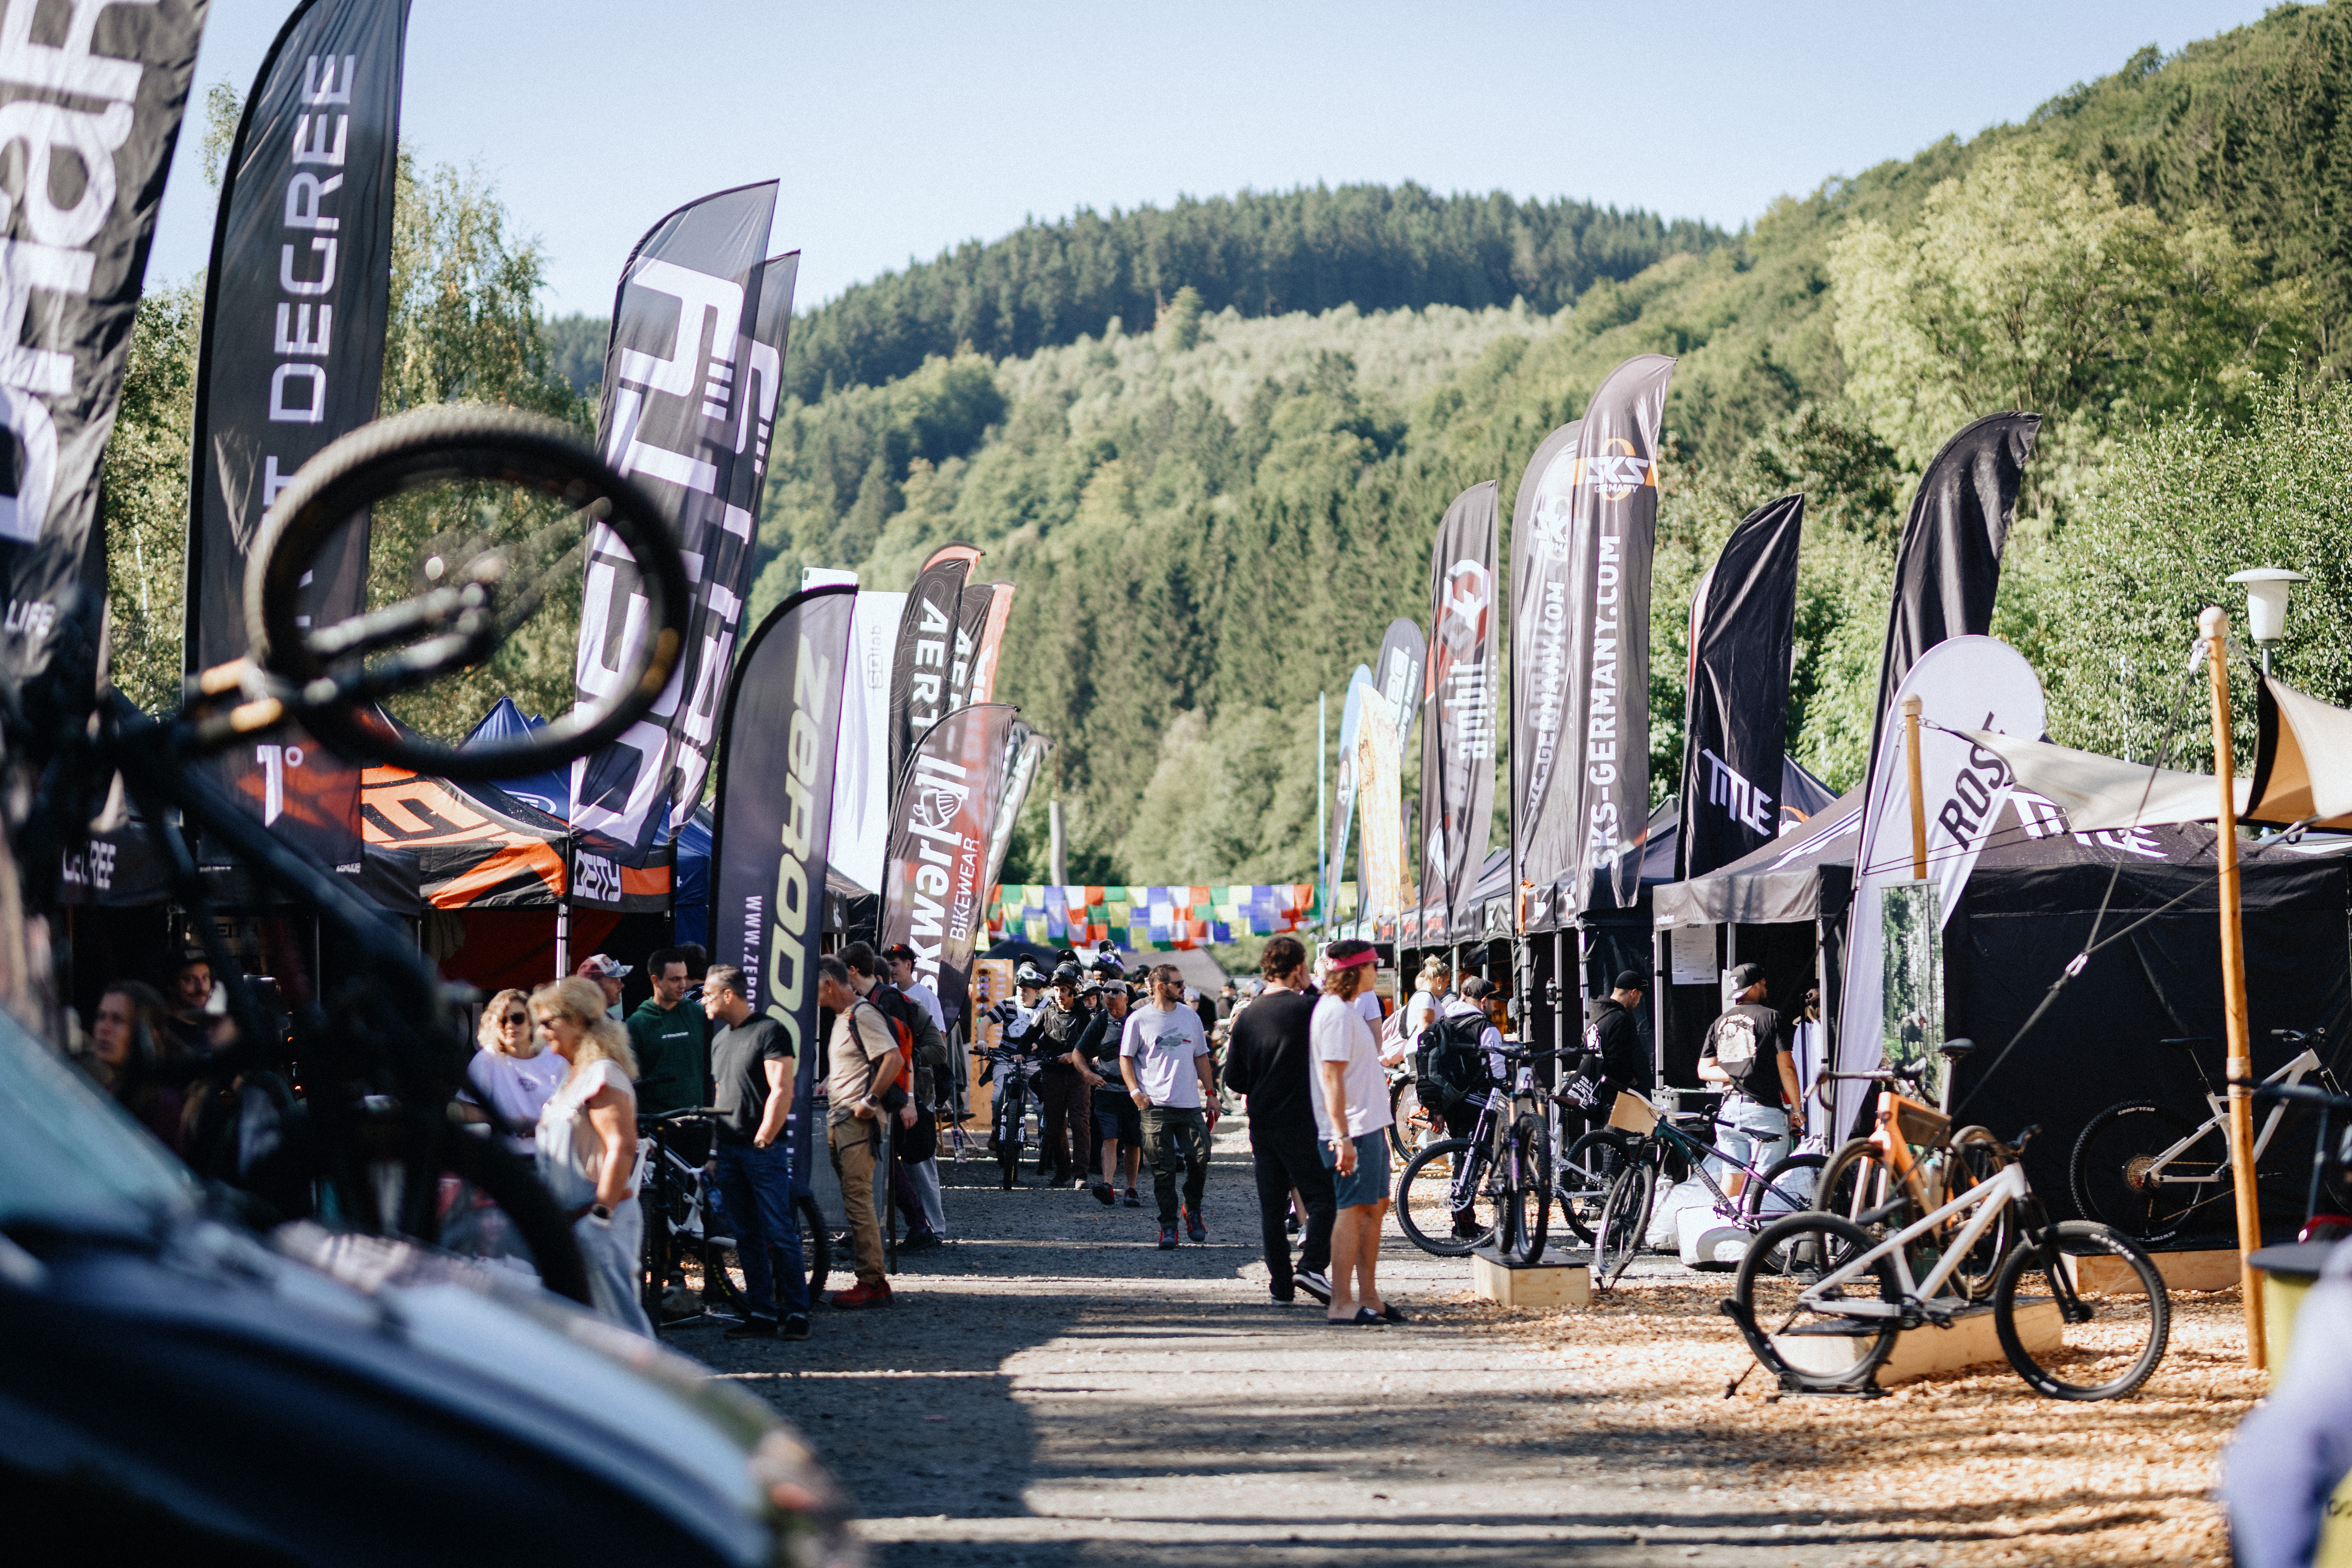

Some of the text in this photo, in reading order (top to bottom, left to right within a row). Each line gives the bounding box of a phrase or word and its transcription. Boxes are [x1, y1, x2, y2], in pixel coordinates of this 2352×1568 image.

[269, 54, 355, 424] DEGREE
[1585, 456, 1649, 484] SKS
[1444, 655, 1488, 760] ambit
[1589, 535, 1621, 870] SKS-GERMANY.COM
[1702, 748, 1773, 836] TITLE
[2007, 791, 2169, 858] TILE
[572, 848, 622, 902] DEITY
[949, 837, 979, 942] BIKEWEAR
[2117, 1106, 2156, 1115] GOODYEAR
